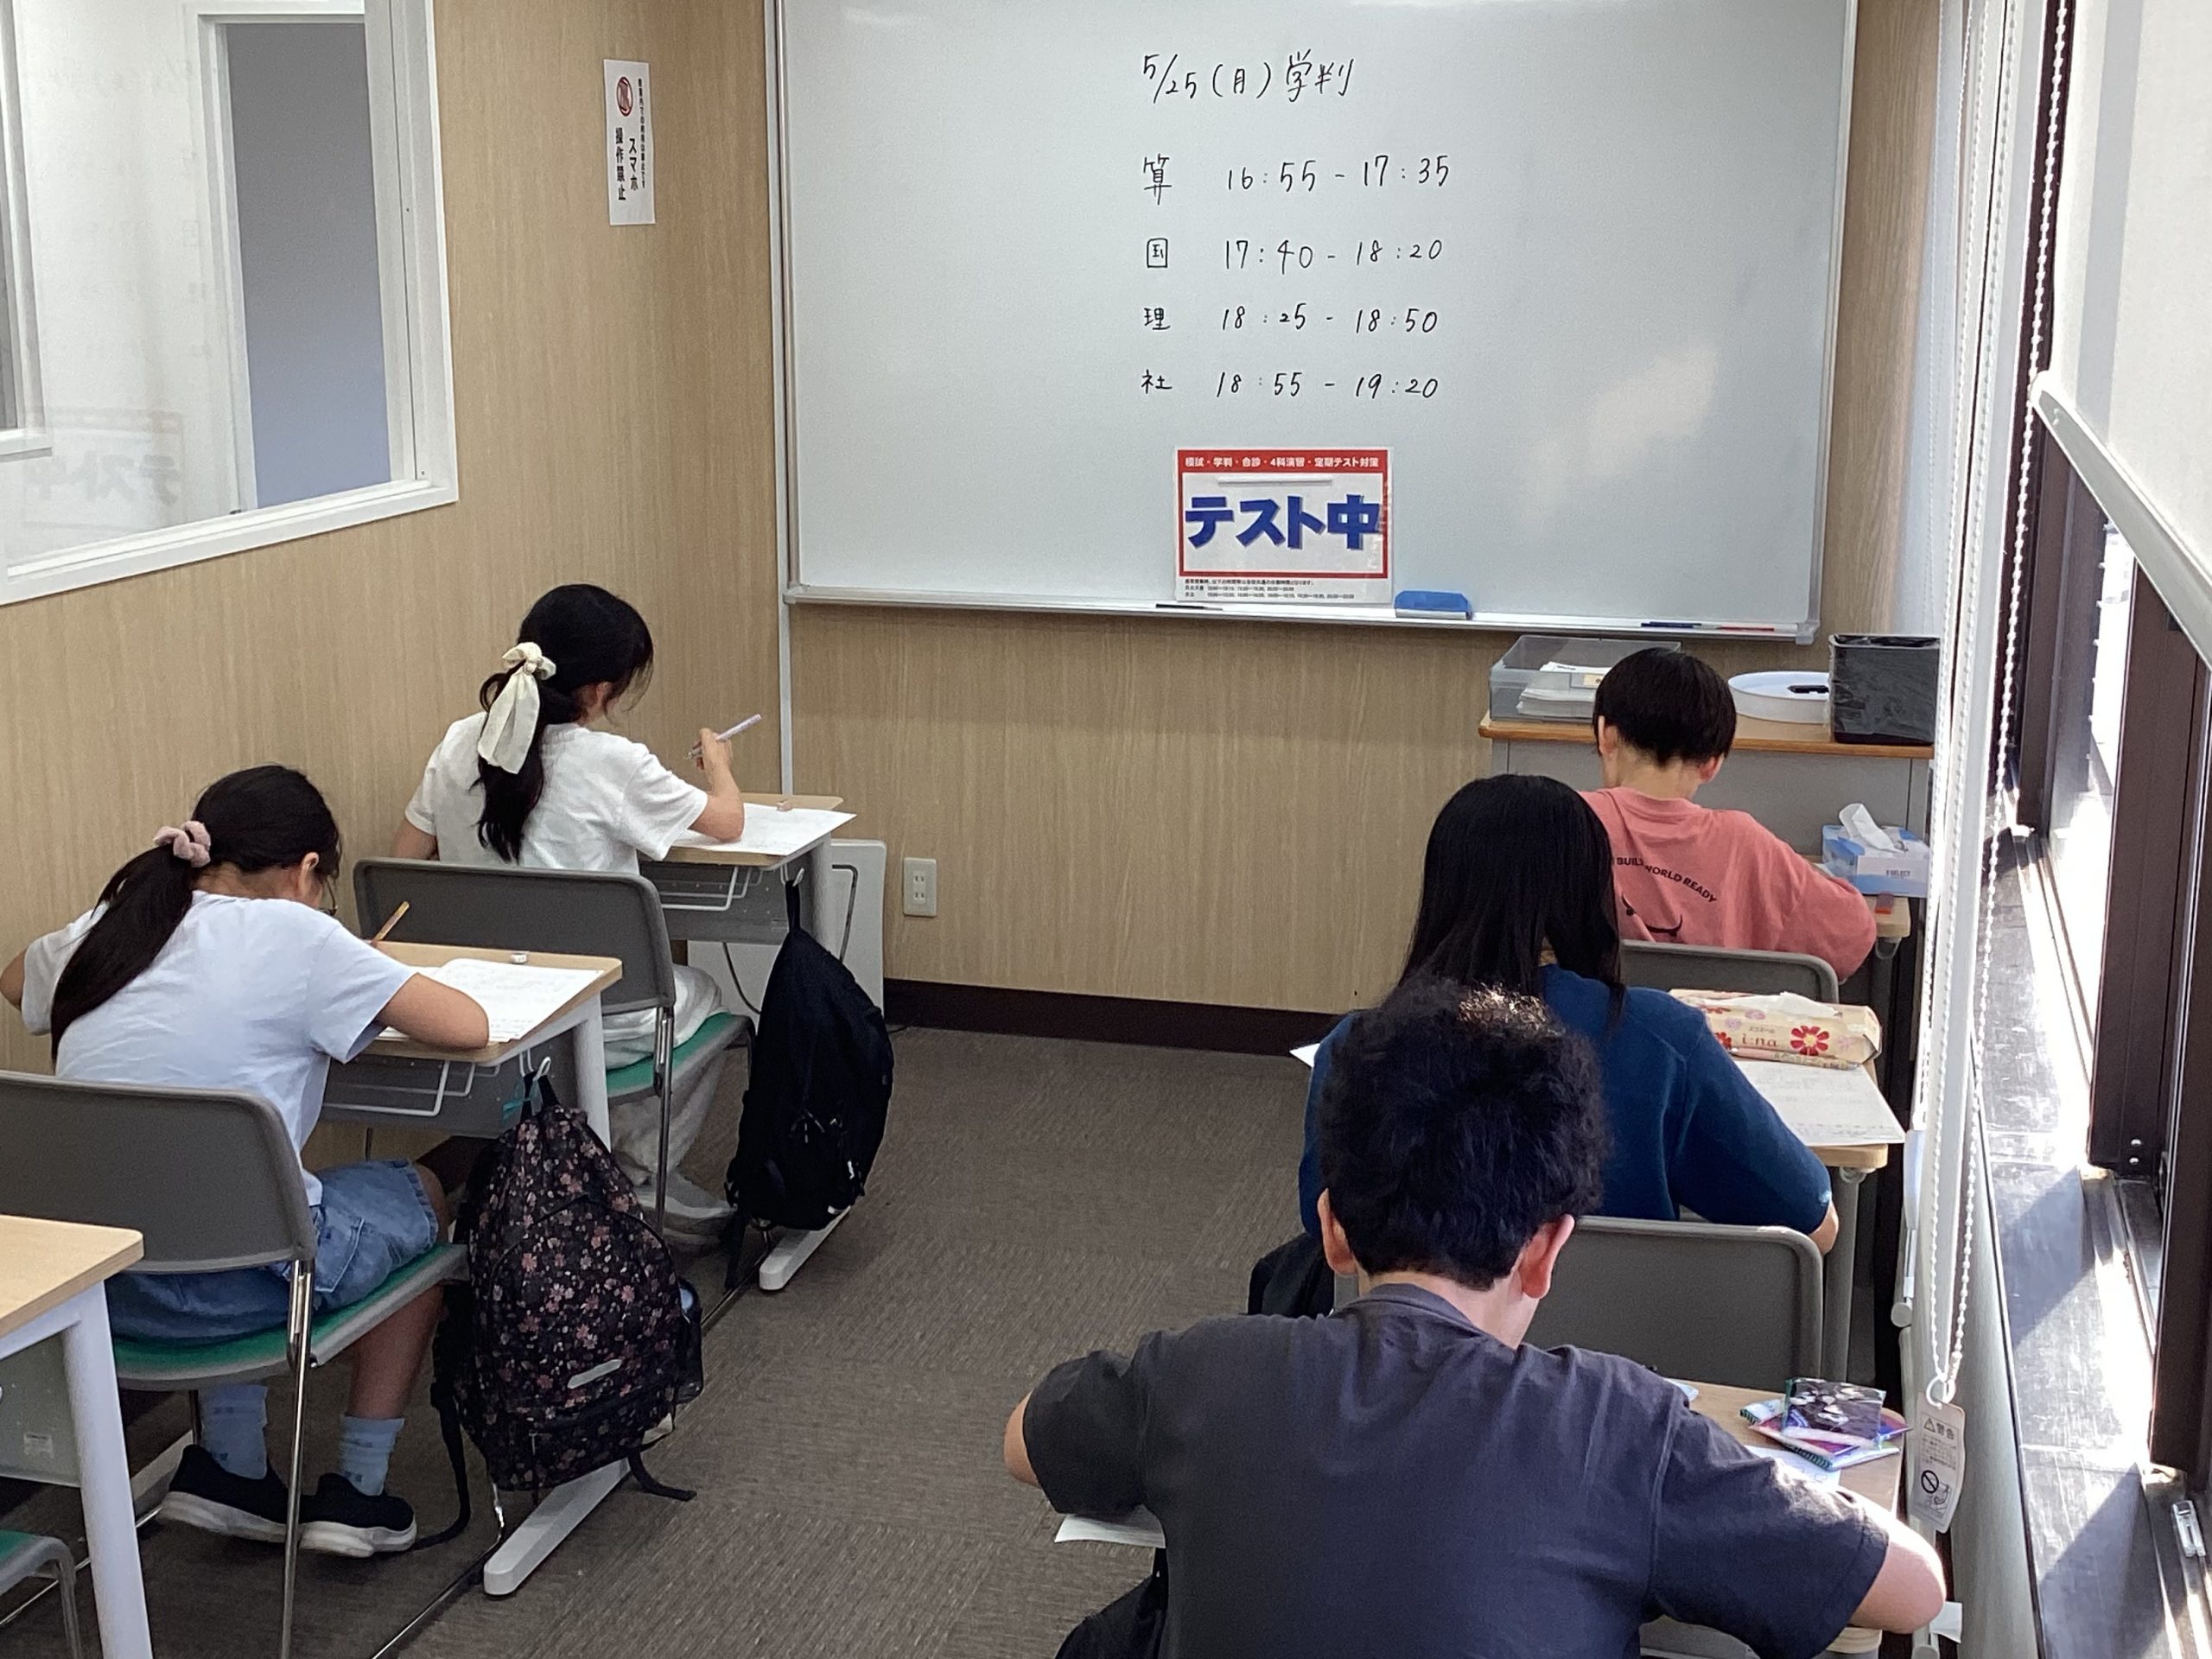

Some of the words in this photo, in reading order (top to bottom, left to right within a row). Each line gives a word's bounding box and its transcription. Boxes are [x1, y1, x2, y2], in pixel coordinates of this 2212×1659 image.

[629, 138, 639, 191] スマホ
[1143, 153, 1173, 206] 算
[1147, 238, 1168, 269] 国
[1143, 308, 1171, 330] 理
[1141, 369, 1173, 394] 社
[1185, 494, 1381, 550] テスト中
[1683, 877, 1717, 903] READY
